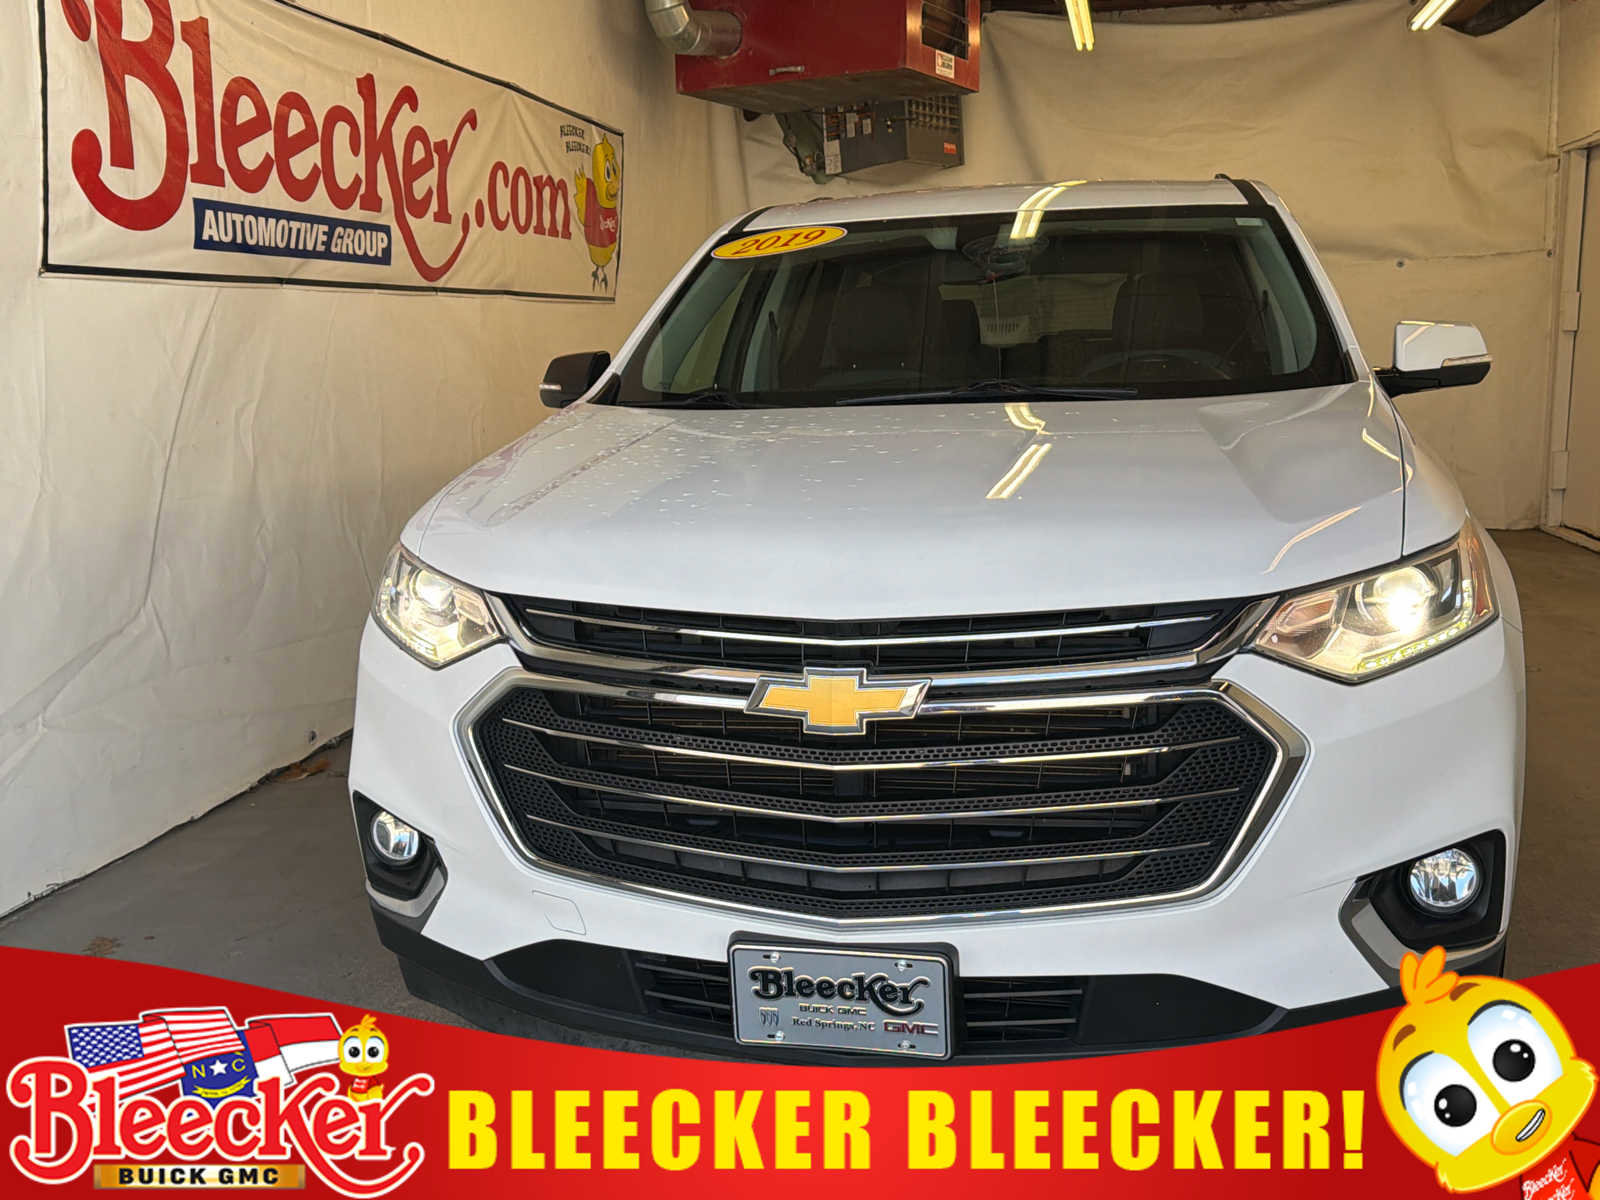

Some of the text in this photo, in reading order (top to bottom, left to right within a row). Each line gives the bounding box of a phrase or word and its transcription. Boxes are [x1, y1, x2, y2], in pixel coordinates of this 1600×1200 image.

[201, 209, 389, 258] AUTOMOTIVE GROUP
[730, 229, 826, 256] 2019
[748, 965, 930, 1016] Bleecker
[799, 1003, 867, 1016] BUICK GMC
[792, 1016, 813, 1027] Red
[883, 1019, 939, 1036] GMC
